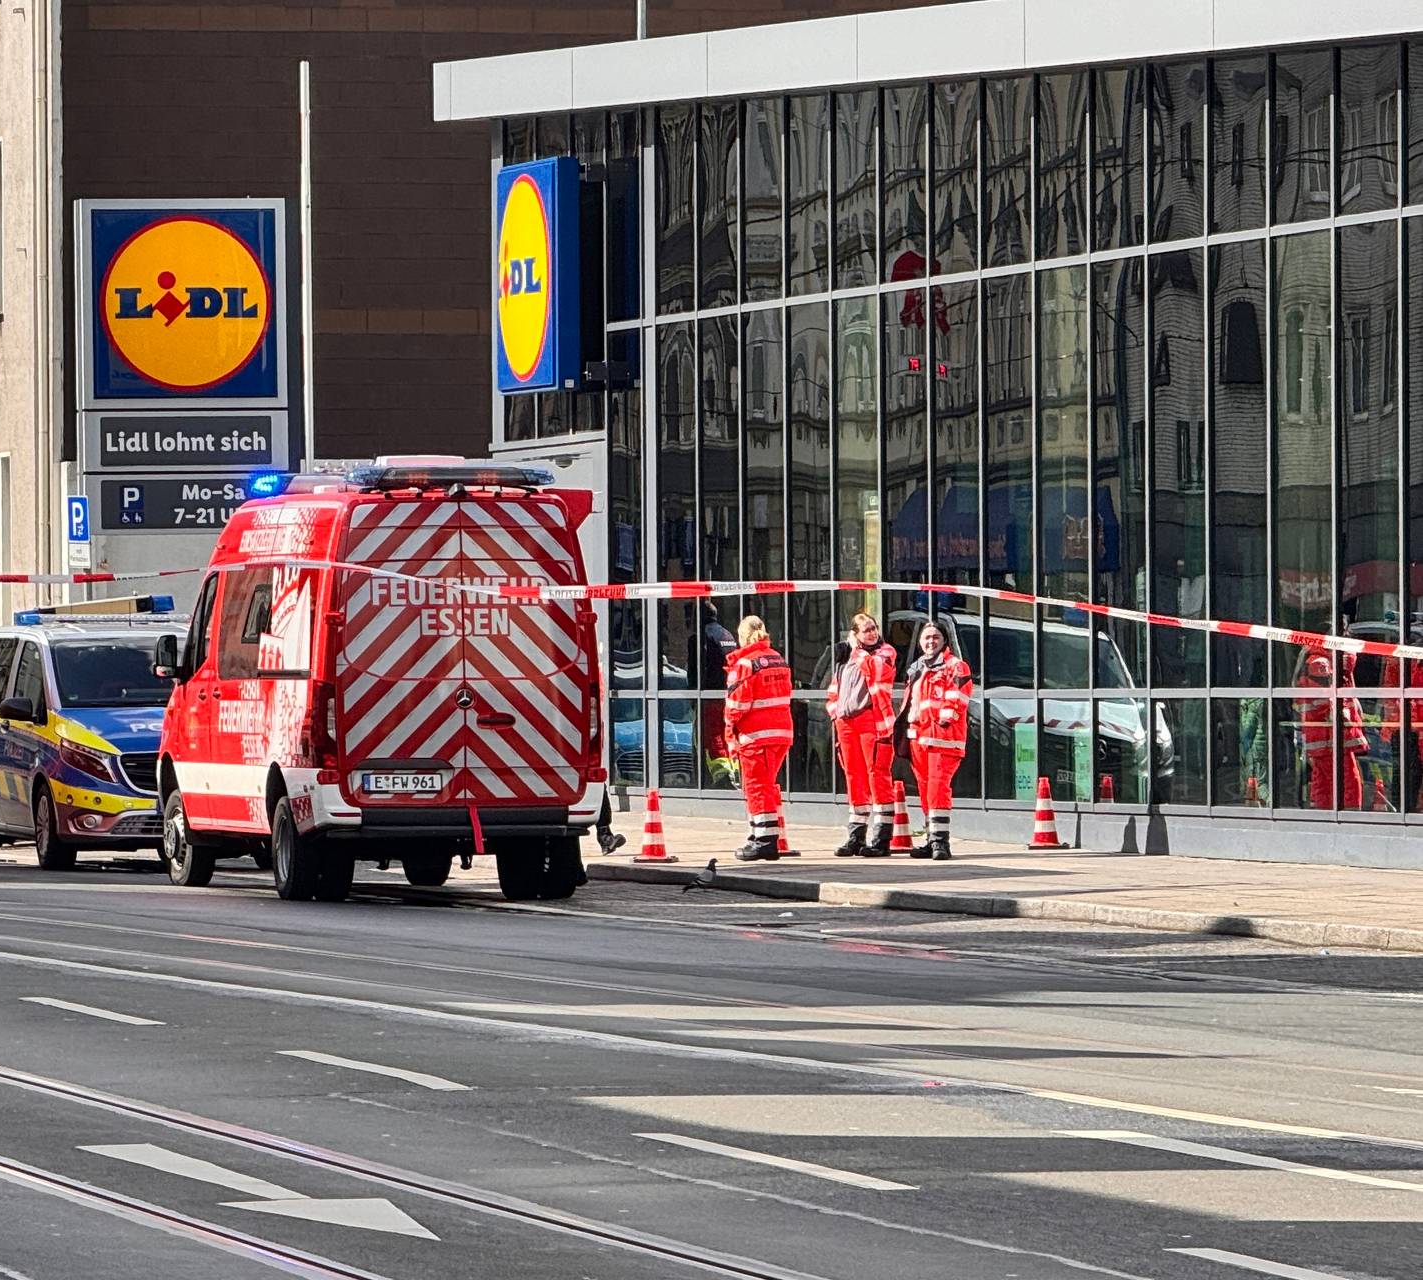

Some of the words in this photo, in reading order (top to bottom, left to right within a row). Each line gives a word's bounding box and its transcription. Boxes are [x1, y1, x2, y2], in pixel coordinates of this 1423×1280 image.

[106, 431, 149, 452] Lidl
[155, 431, 215, 451] lohnt
[221, 430, 267, 451] sich
[123, 487, 140, 508] P
[72, 502, 84, 536] P
[371, 576, 549, 606] FEUERWEHR
[421, 608, 510, 636] ESSEN
[374, 777, 385, 789] E
[392, 777, 409, 789] FW
[412, 776, 437, 789] 961
